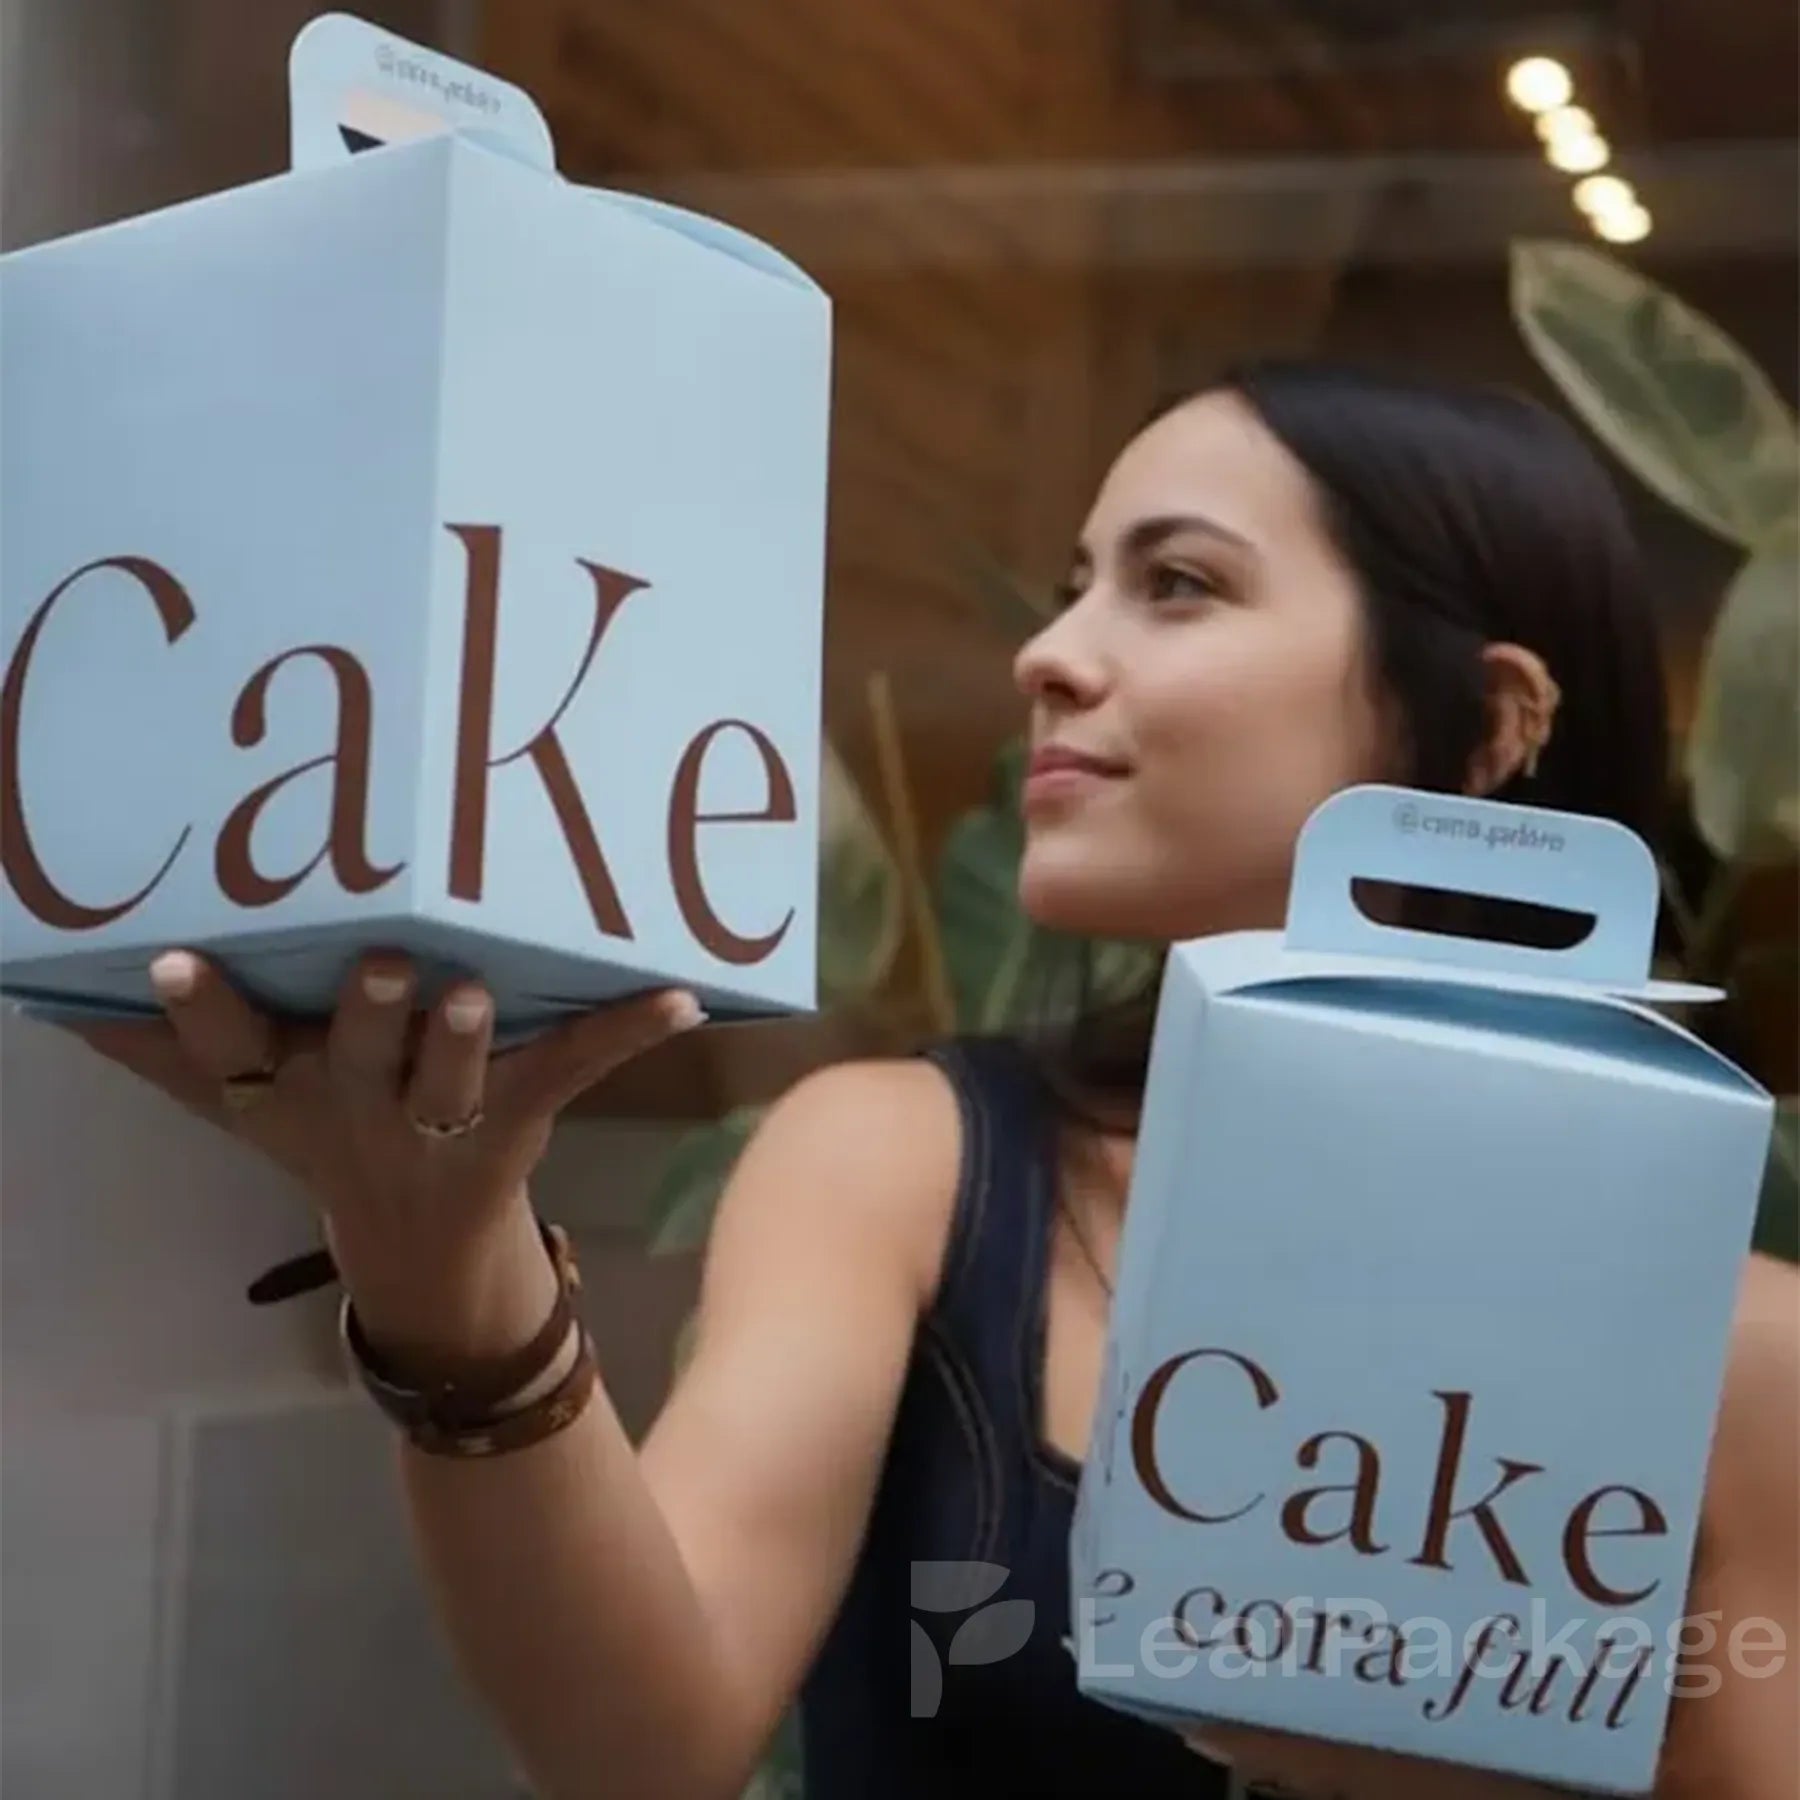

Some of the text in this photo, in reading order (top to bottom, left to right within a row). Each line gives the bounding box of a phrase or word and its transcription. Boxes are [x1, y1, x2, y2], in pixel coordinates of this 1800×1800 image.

[1131, 1348, 1669, 1609] Cake
[1172, 1586, 1409, 1688] cora
[1422, 1613, 1656, 1730] full
